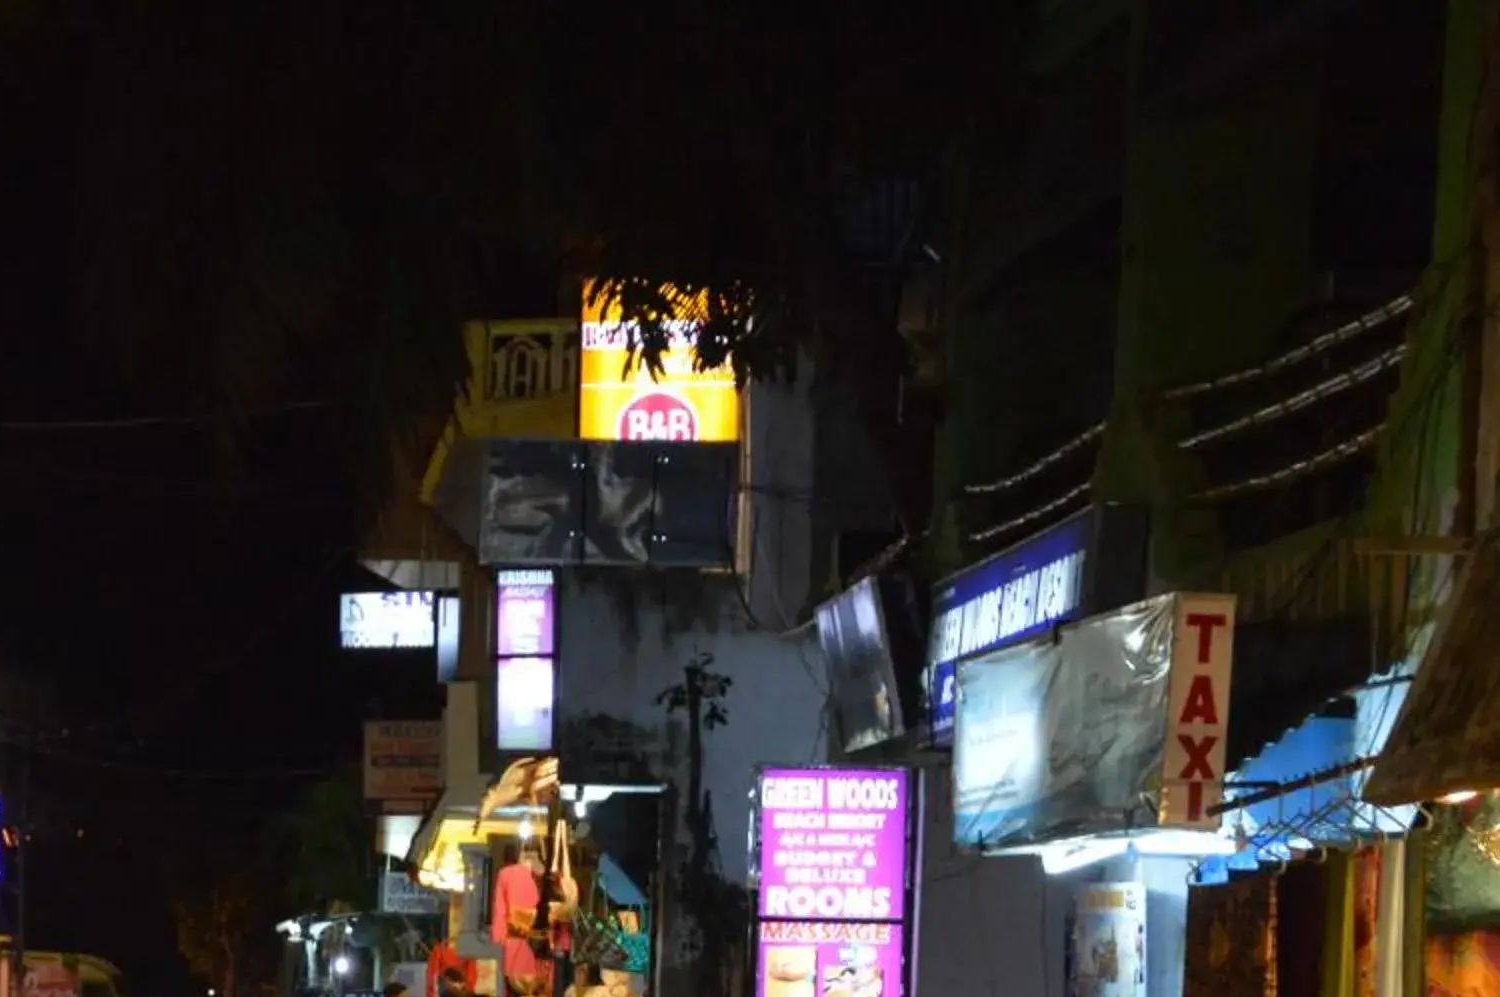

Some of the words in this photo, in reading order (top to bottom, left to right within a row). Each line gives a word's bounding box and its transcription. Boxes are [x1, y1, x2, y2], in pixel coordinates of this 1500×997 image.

[1177, 613, 1227, 821] TAXI
[762, 777, 823, 808] GREEN
[827, 778, 898, 809] WOODS
[766, 886, 891, 918] ROOMS
[761, 922, 890, 944] MASSAGE
